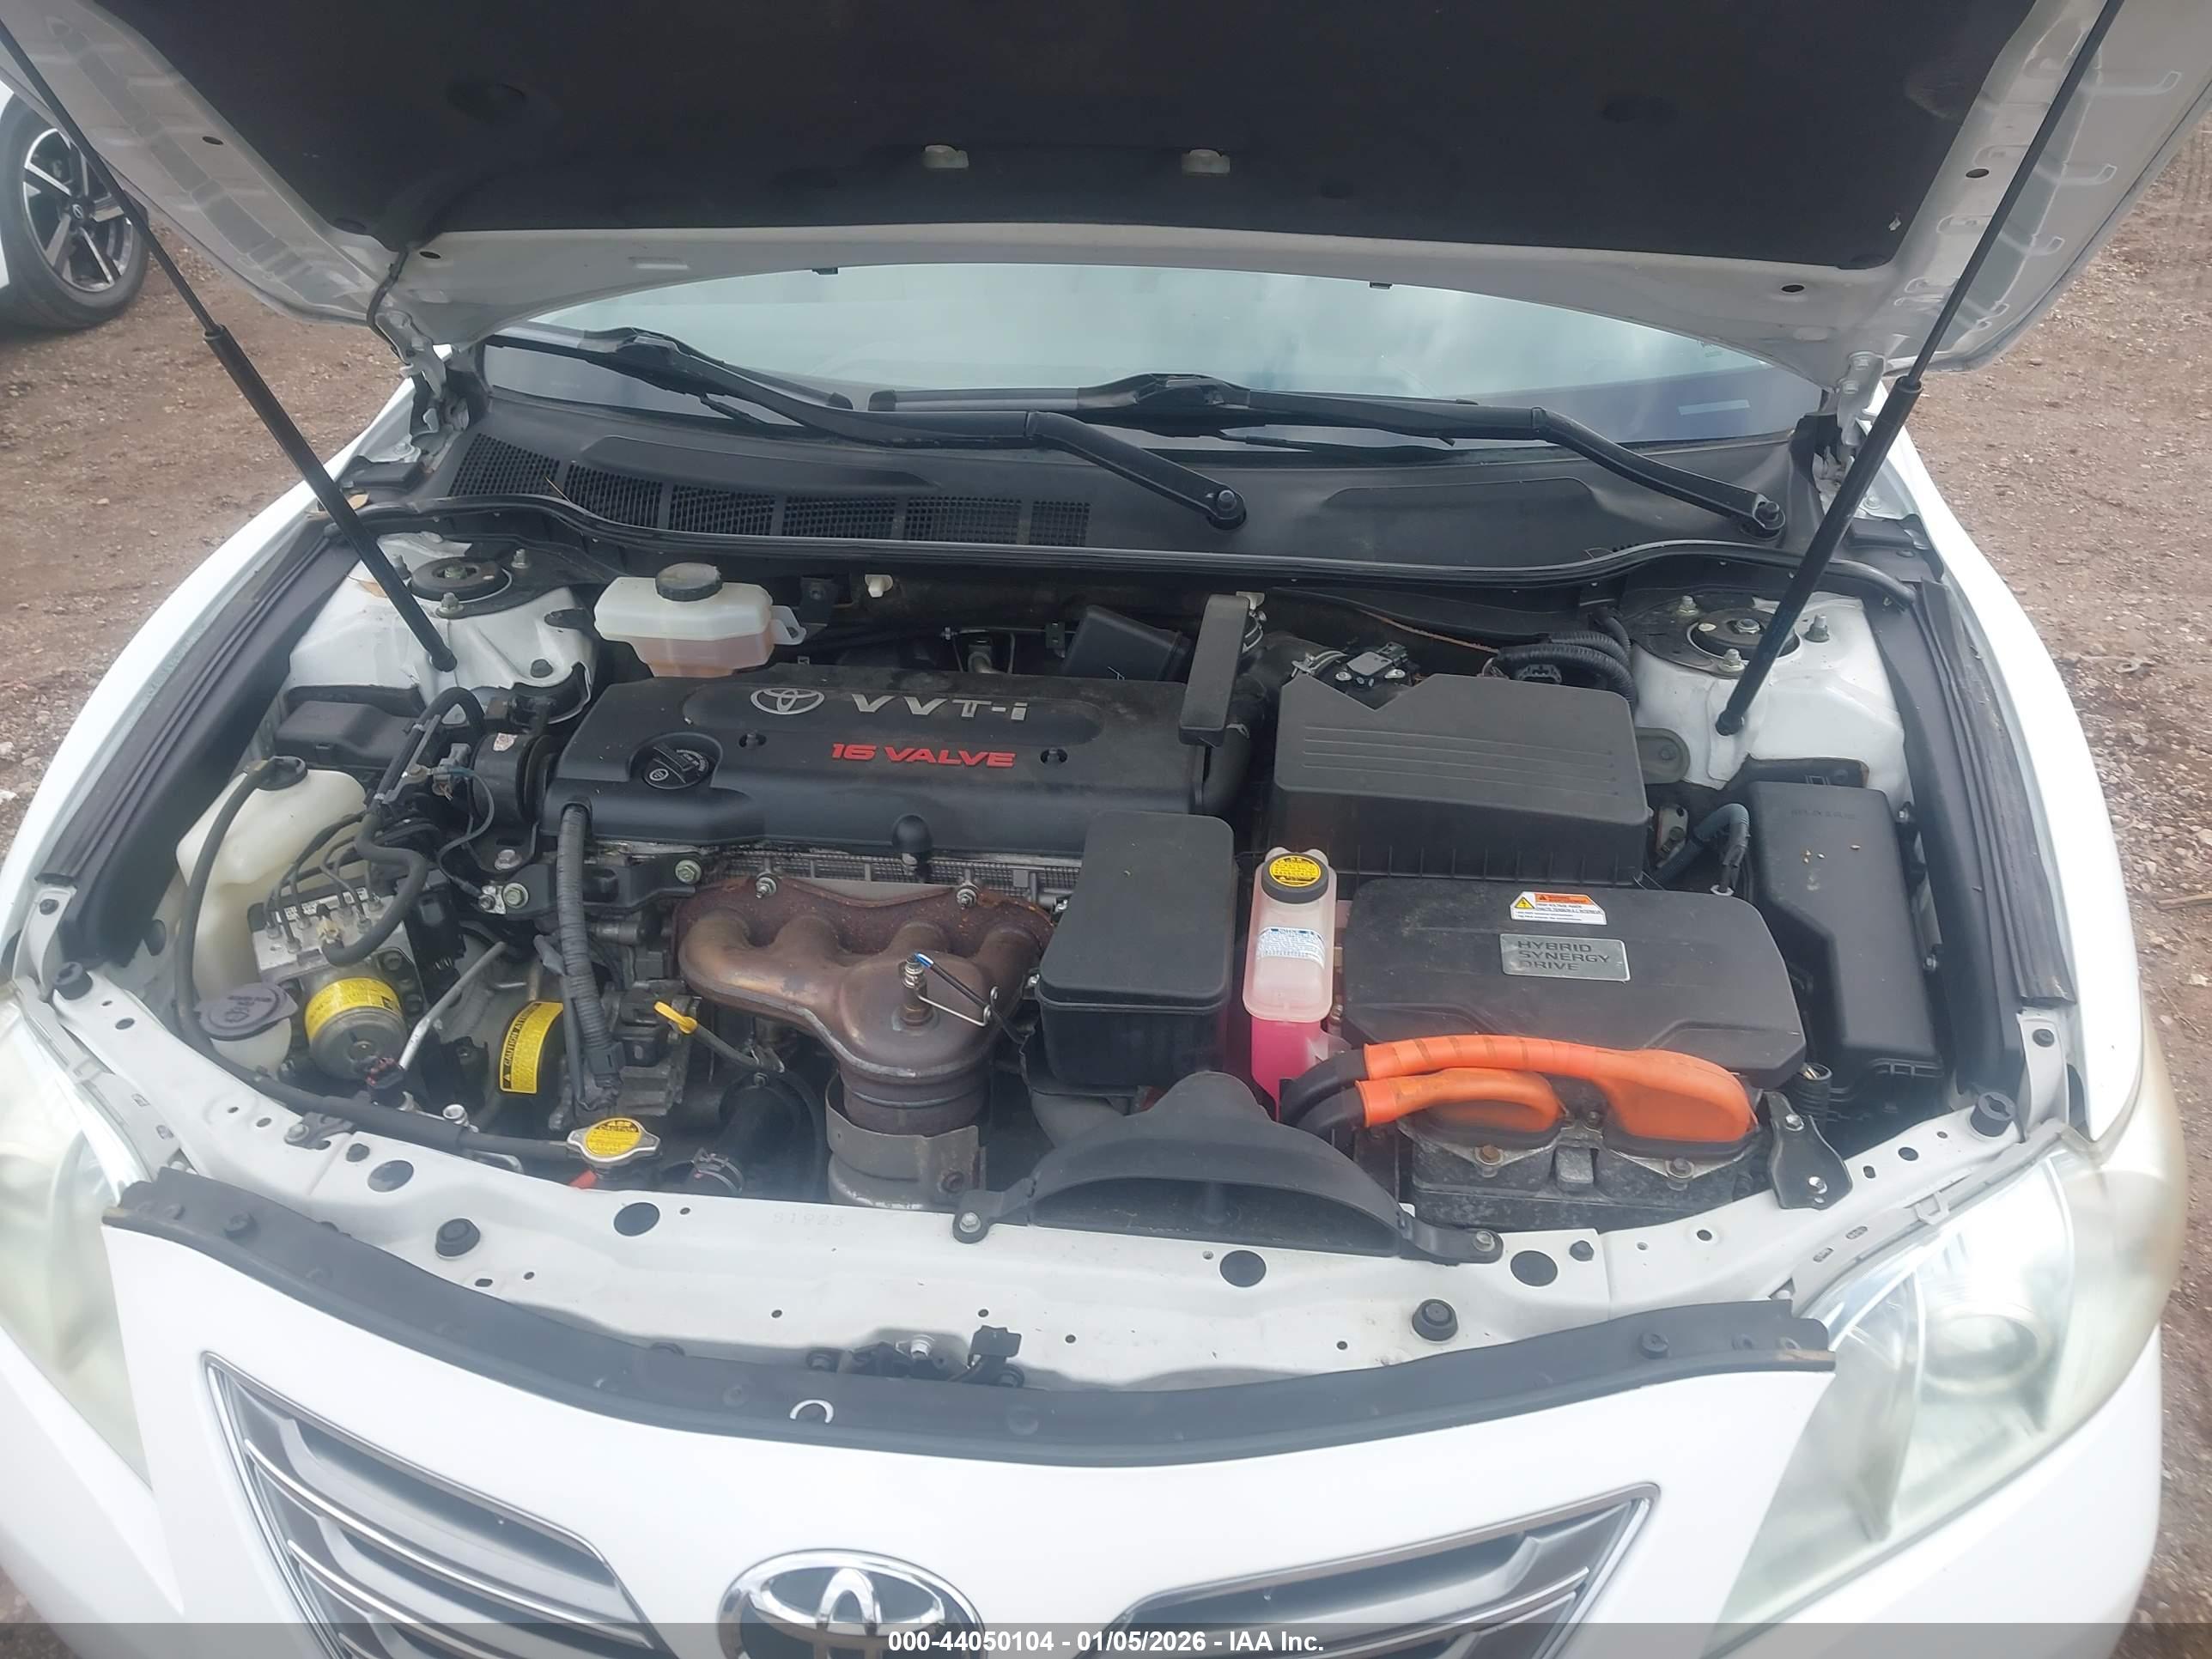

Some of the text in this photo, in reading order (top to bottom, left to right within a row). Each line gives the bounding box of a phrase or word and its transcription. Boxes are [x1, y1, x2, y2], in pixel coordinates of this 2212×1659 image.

[852, 693, 1029, 721] VVT-i
[831, 743, 1017, 767] 16 VALVE
[1517, 940, 1592, 952] HYBRID
[1518, 950, 1610, 963] SYNERGY
[1520, 960, 1580, 971] DRIVE
